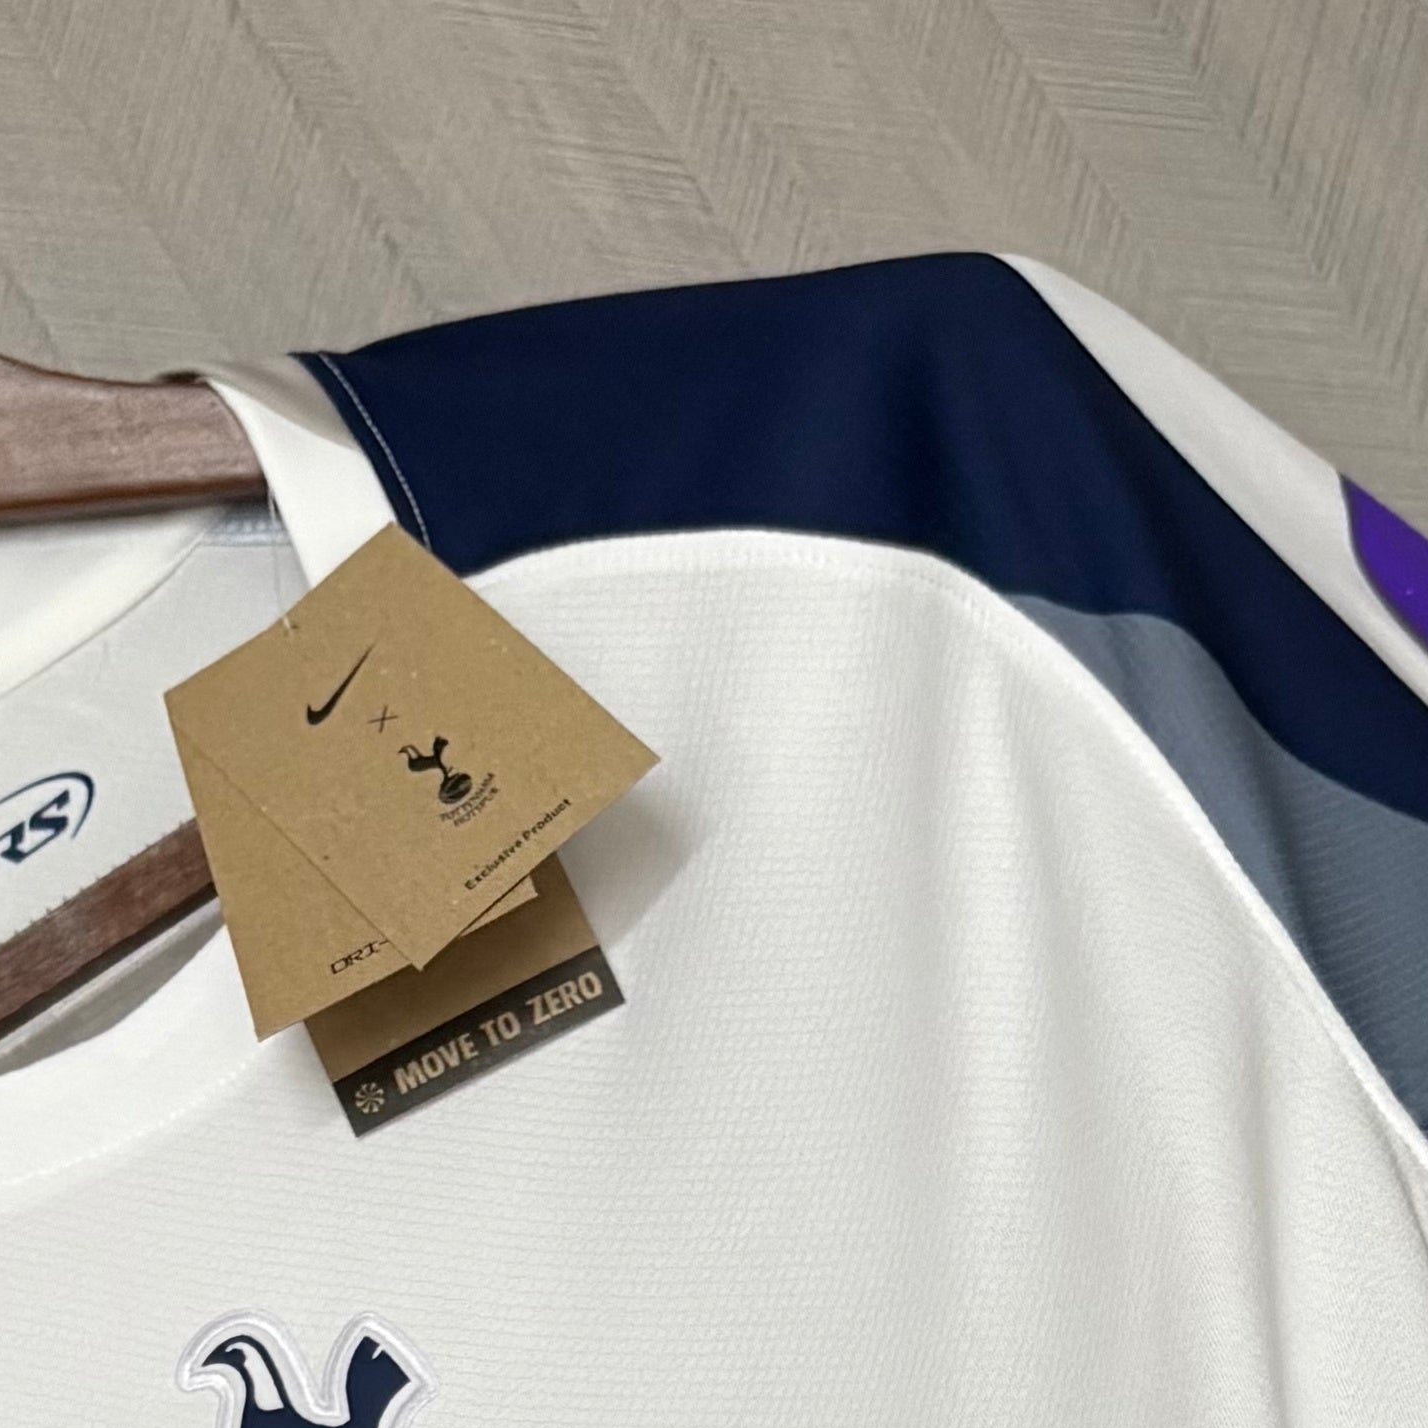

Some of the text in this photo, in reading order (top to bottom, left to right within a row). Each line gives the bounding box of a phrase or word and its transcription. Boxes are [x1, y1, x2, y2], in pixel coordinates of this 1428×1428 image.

[464, 797, 572, 891] Exclusive Product
[393, 971, 603, 1095] MOVE TO ZERO
